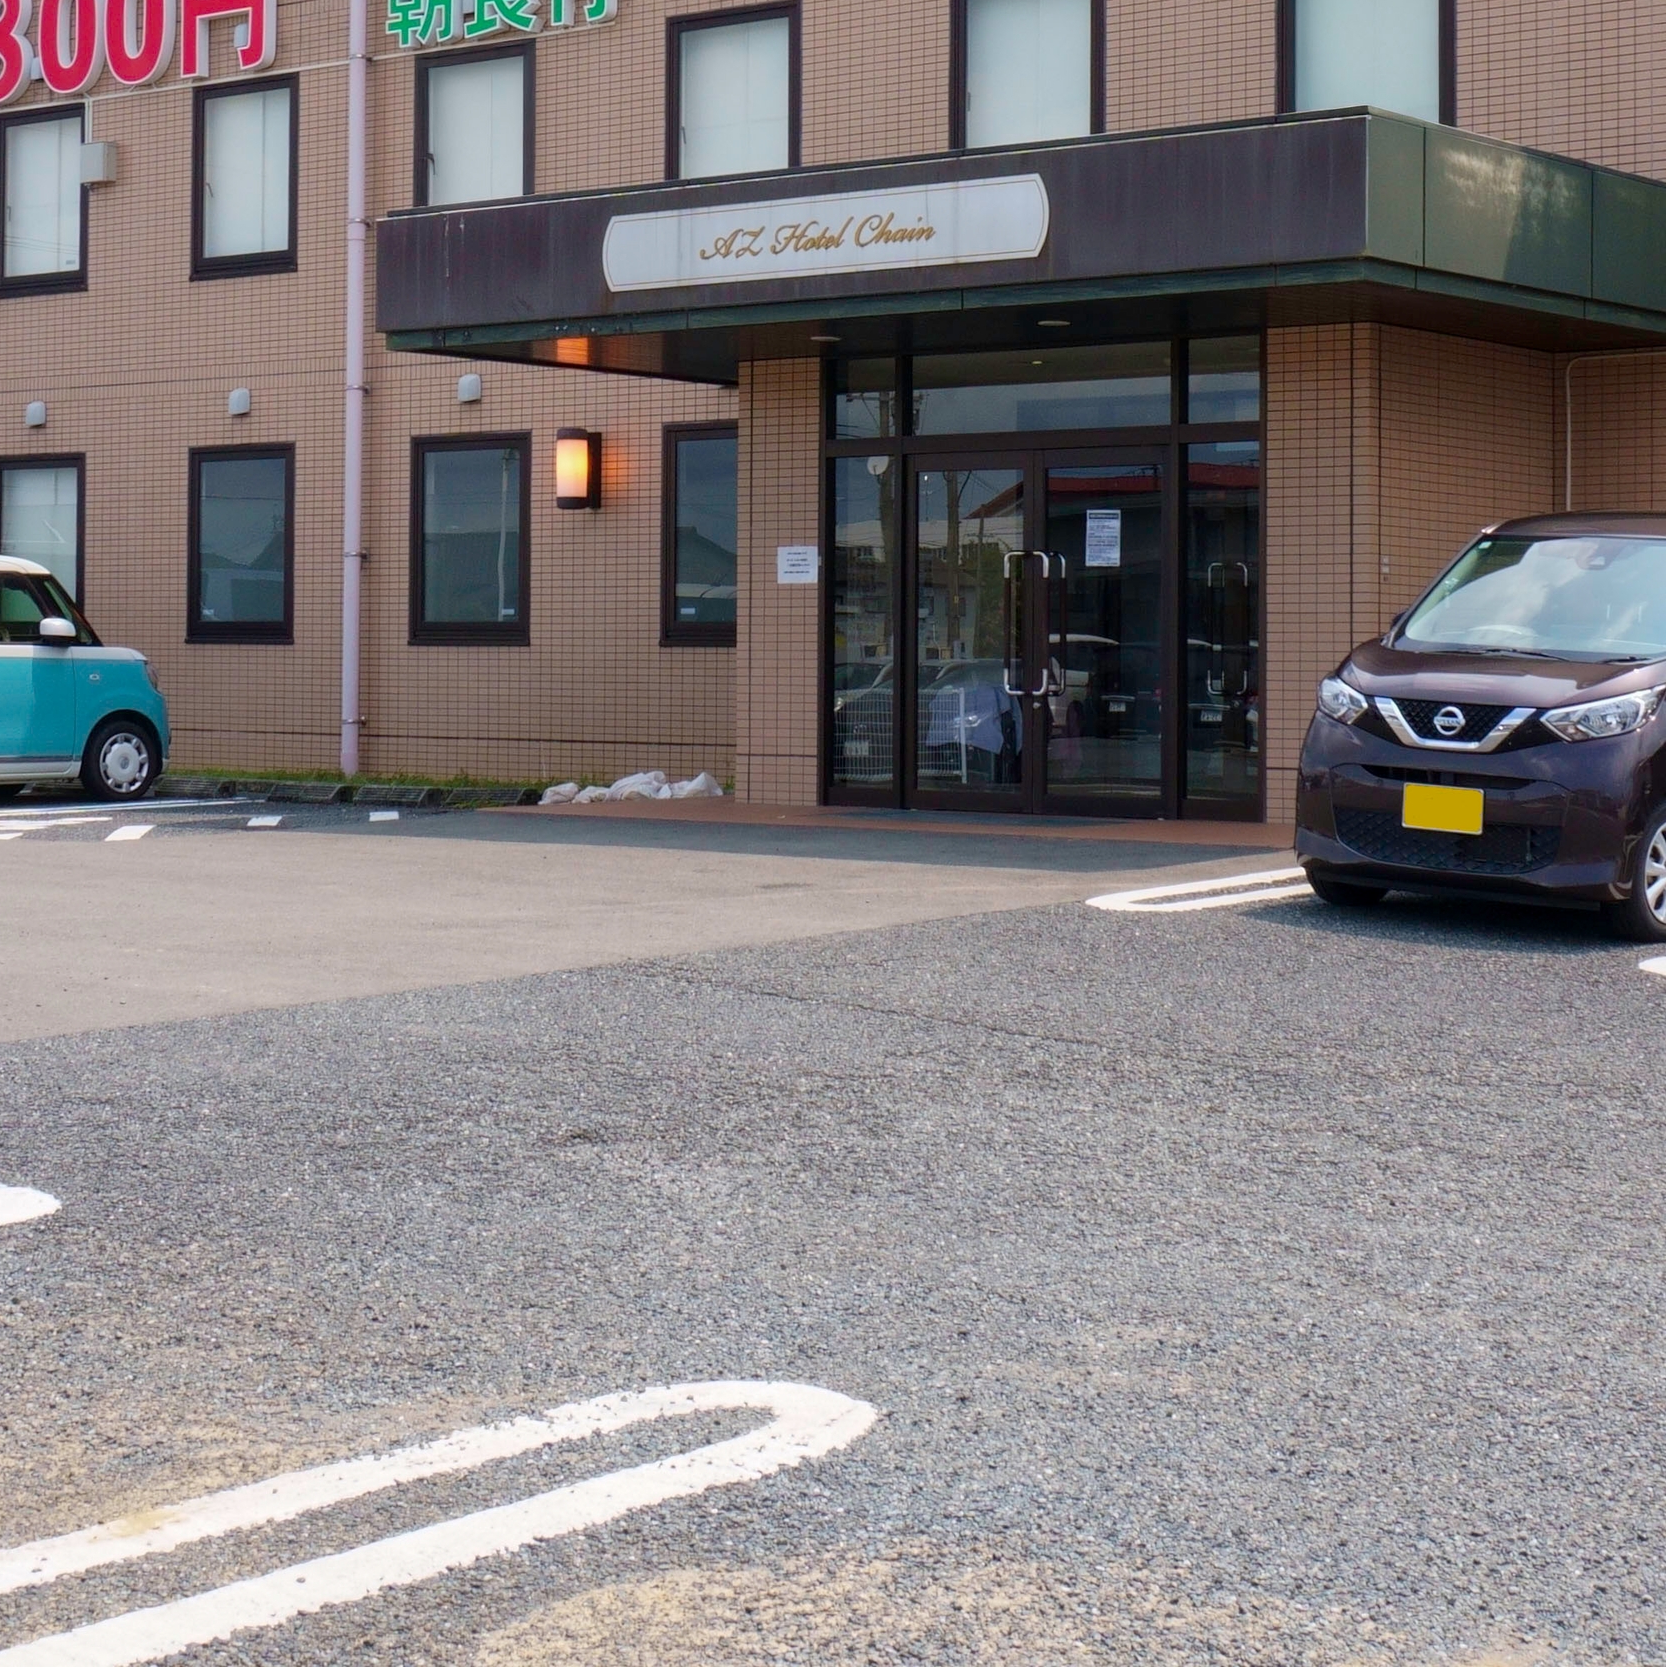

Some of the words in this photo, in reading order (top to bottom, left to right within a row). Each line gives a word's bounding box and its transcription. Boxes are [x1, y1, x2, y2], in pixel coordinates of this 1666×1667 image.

[699, 226, 765, 260] AZ
[770, 216, 855, 255] Hotel
[854, 212, 935, 248] Chain
